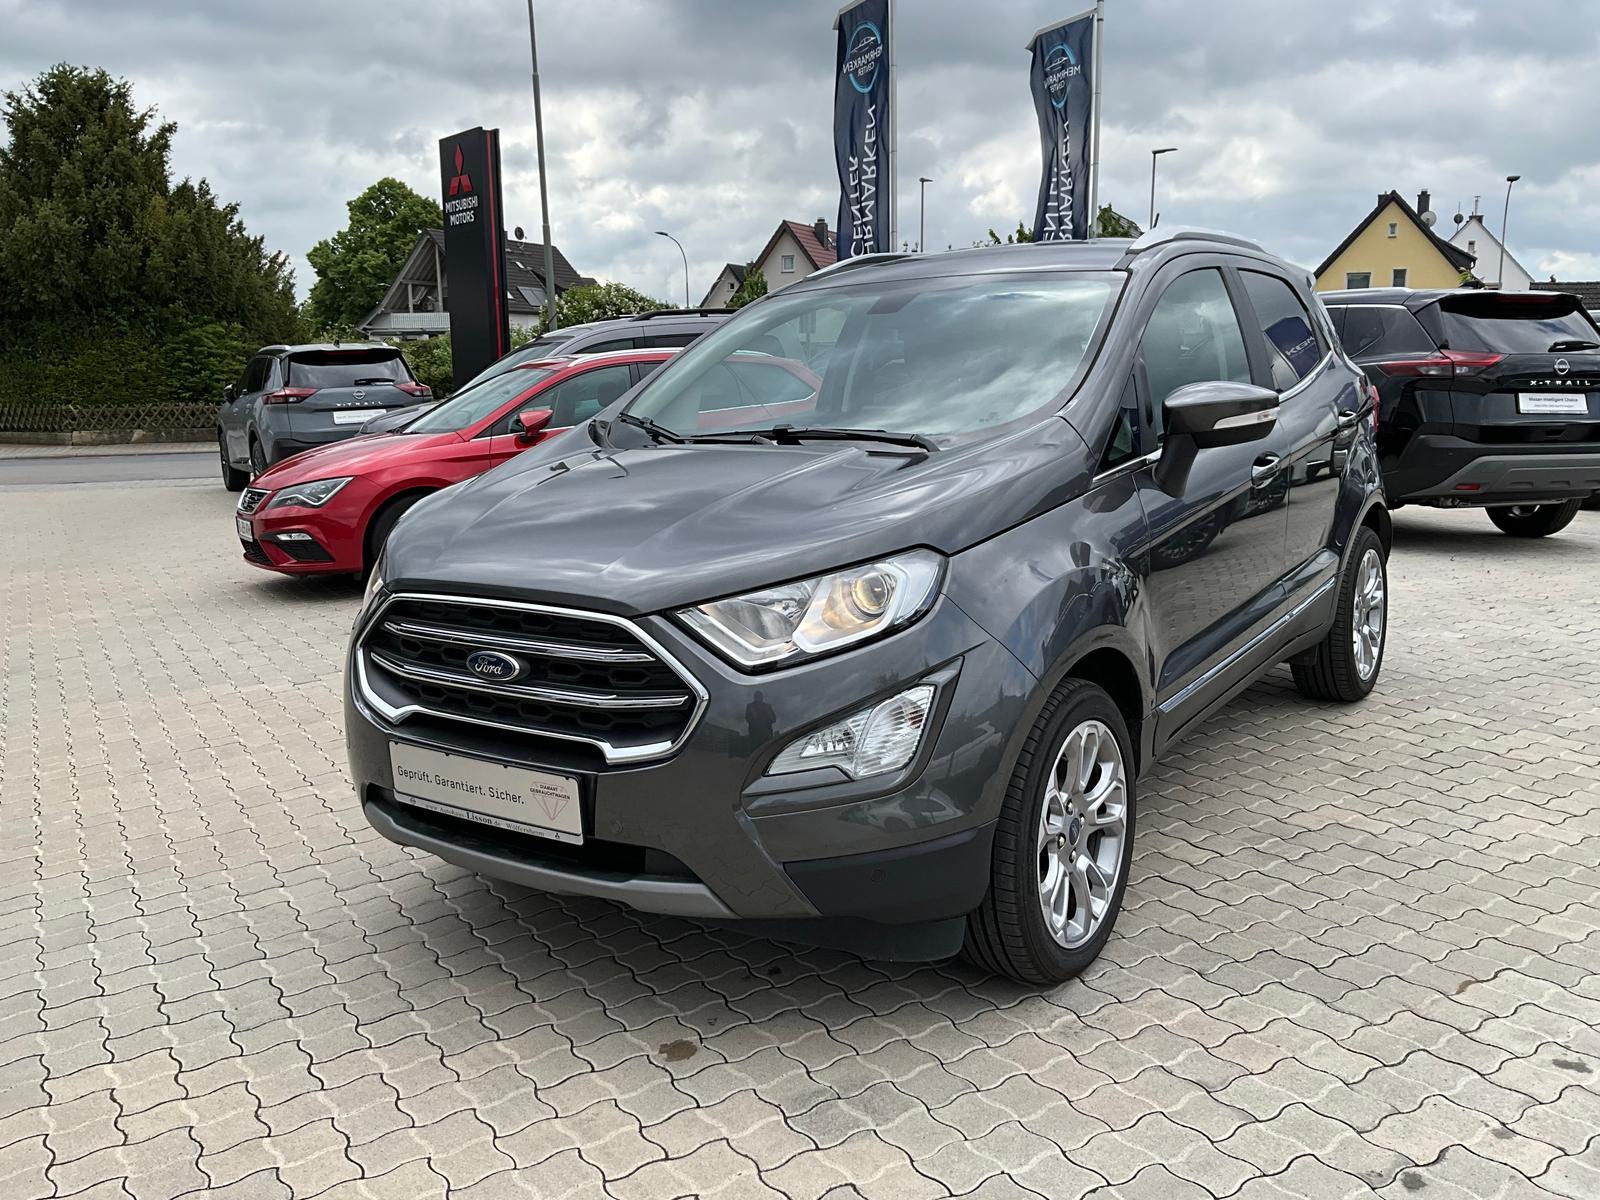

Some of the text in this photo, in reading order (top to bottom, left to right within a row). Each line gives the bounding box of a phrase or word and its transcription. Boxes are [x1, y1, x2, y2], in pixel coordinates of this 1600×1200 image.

[445, 195, 479, 214] MITSUBISHI
[450, 210, 475, 226] MOTORS
[475, 655, 504, 675] Ford
[397, 765, 525, 805] Geprüft. Garantiert. Sicher.
[466, 811, 493, 825] Lisson
